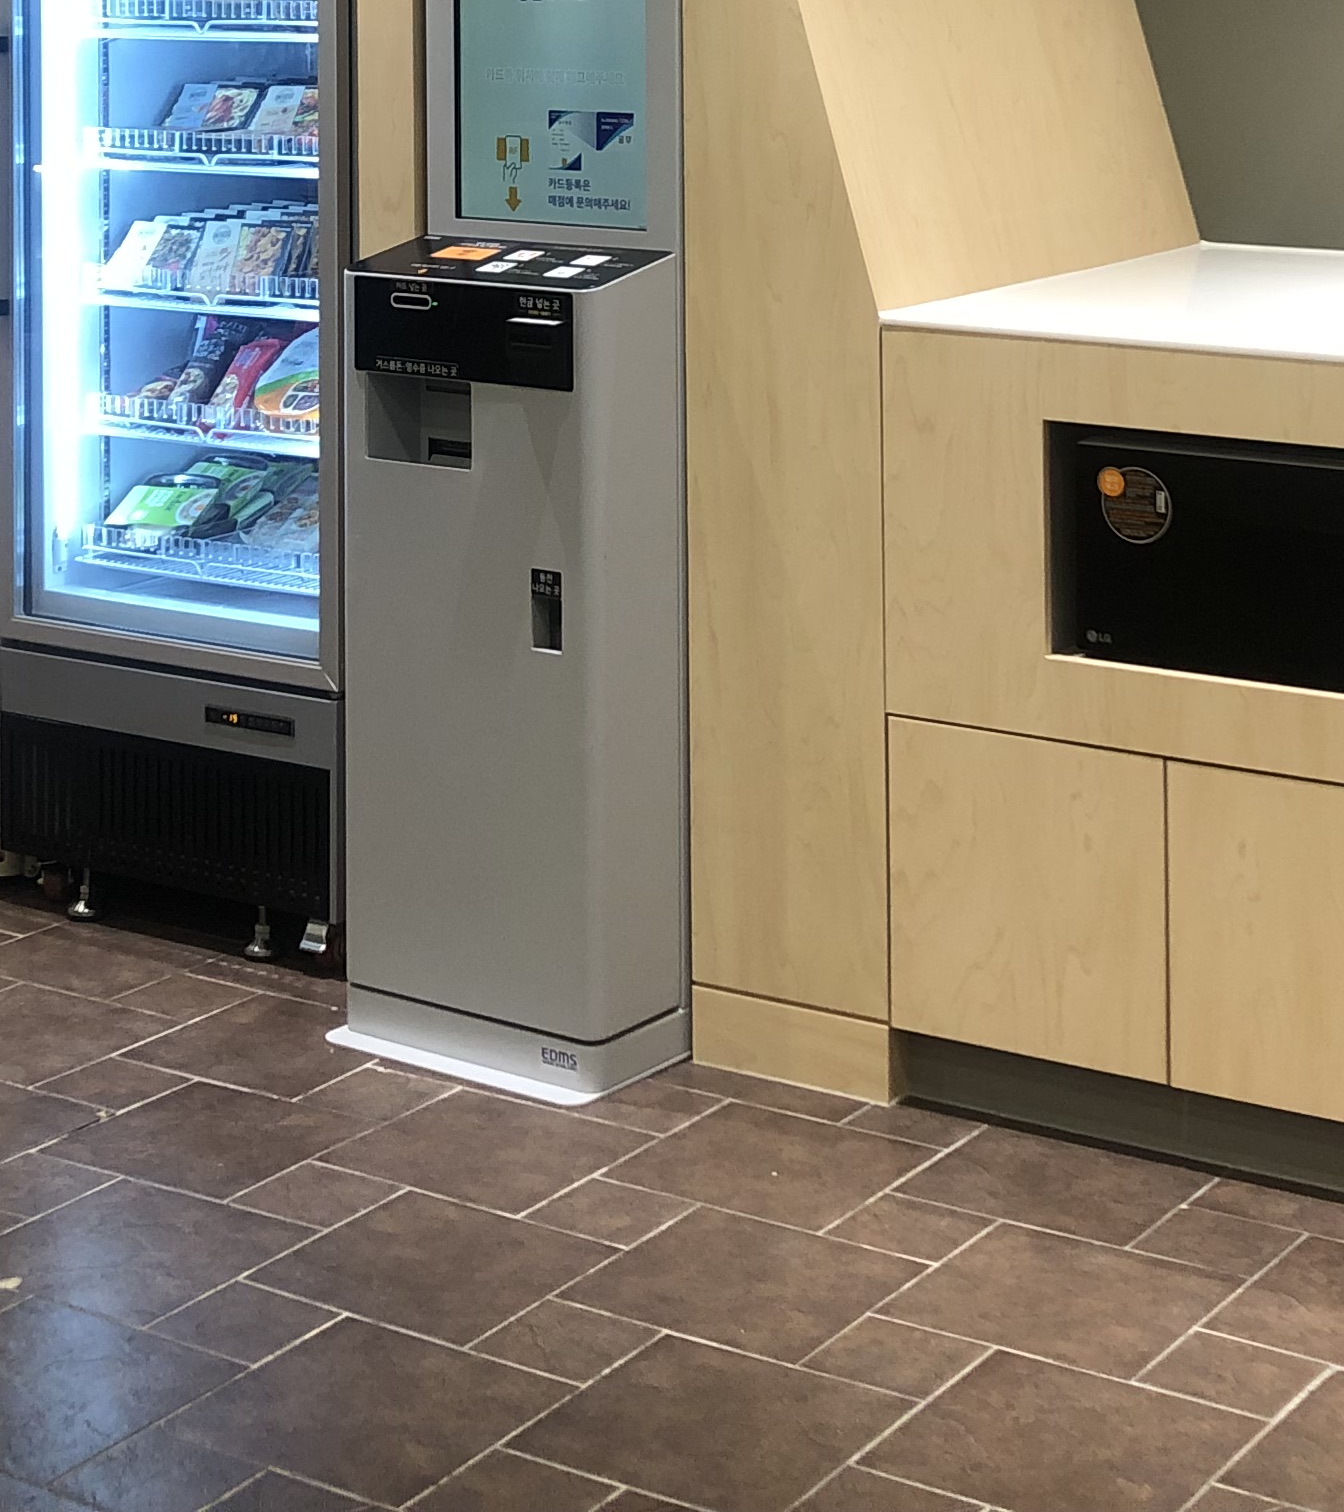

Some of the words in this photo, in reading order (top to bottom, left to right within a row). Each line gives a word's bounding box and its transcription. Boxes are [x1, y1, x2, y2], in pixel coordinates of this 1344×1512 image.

[548, 177, 592, 192] 카드등록은
[548, 194, 574, 209] 매점에
[576, 195, 631, 211] 문의해주세요!
[552, 299, 561, 311] 곳
